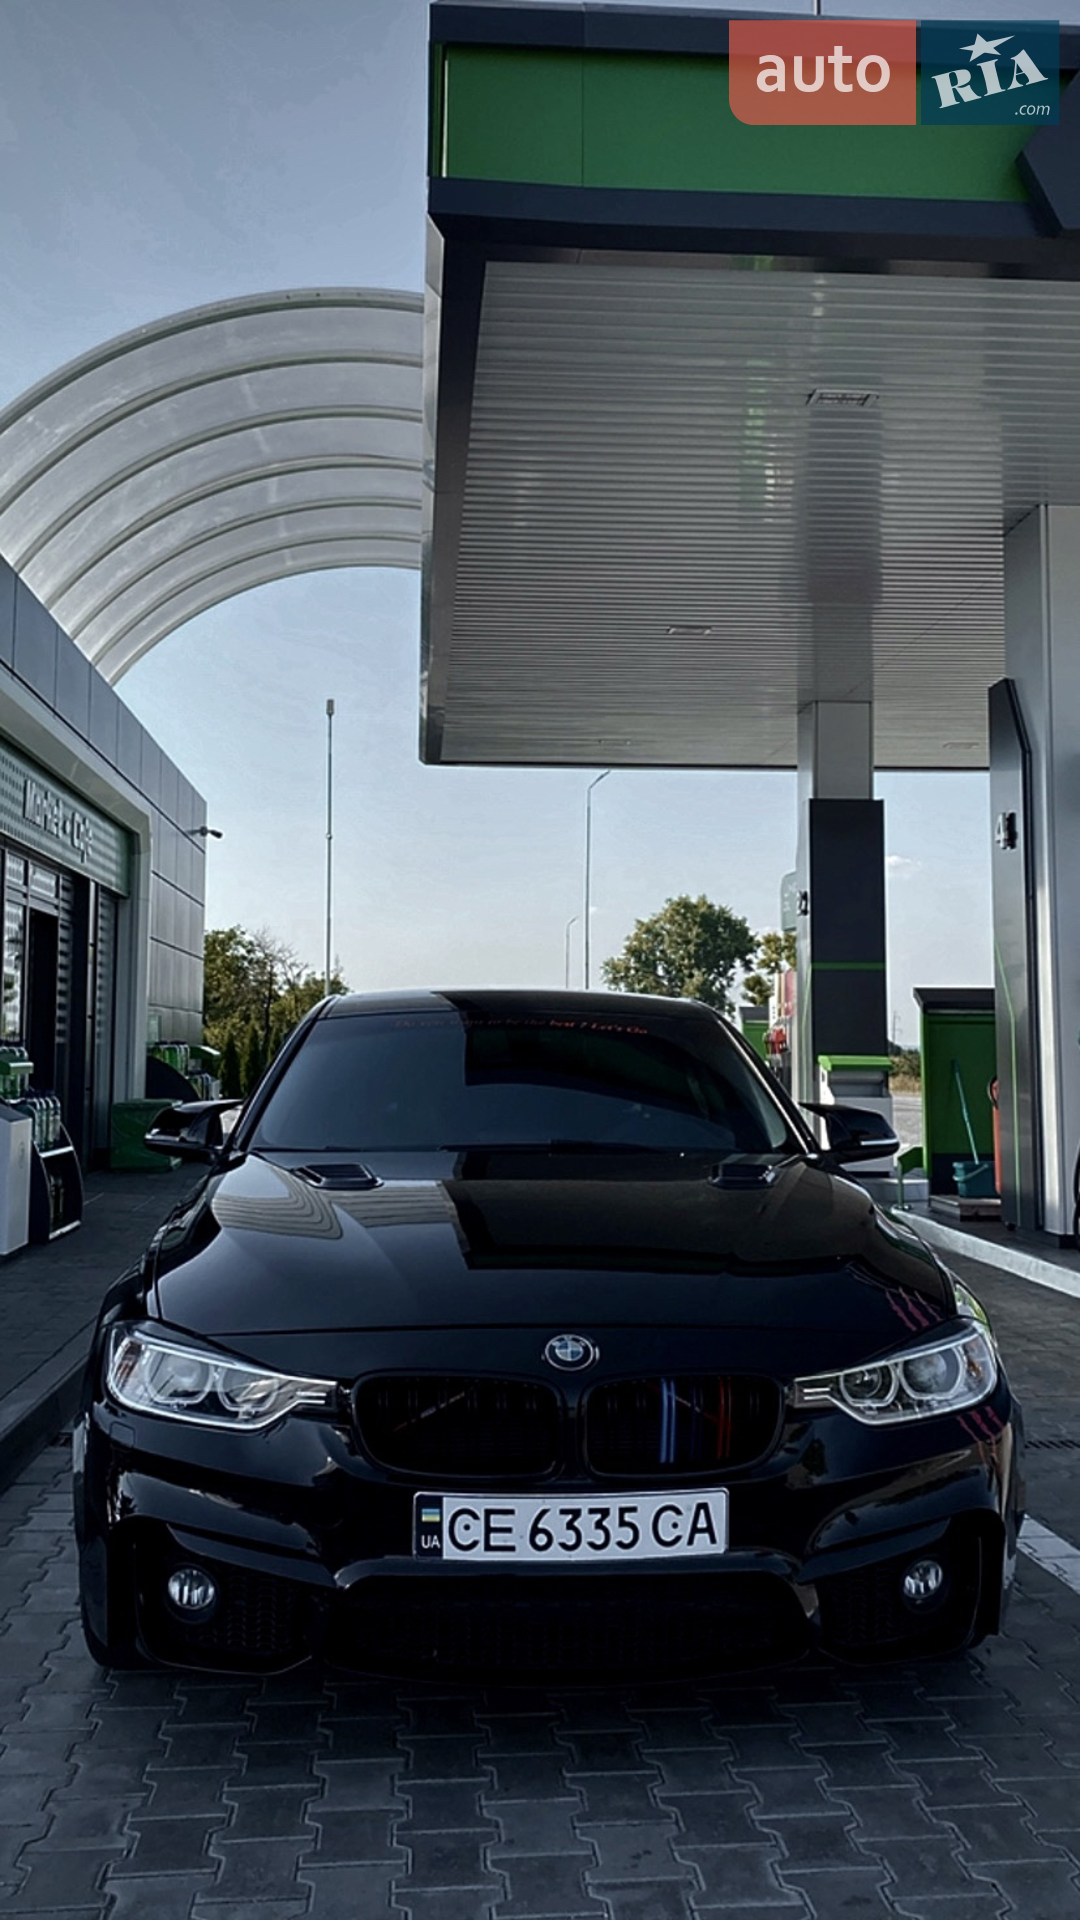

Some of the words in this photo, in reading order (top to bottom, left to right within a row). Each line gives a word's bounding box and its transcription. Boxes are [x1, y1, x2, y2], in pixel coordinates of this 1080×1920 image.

[421, 1534, 440, 1549] UA
[449, 1508, 516, 1552] CE
[528, 1506, 640, 1552] 6335
[652, 1502, 717, 1548] CA
